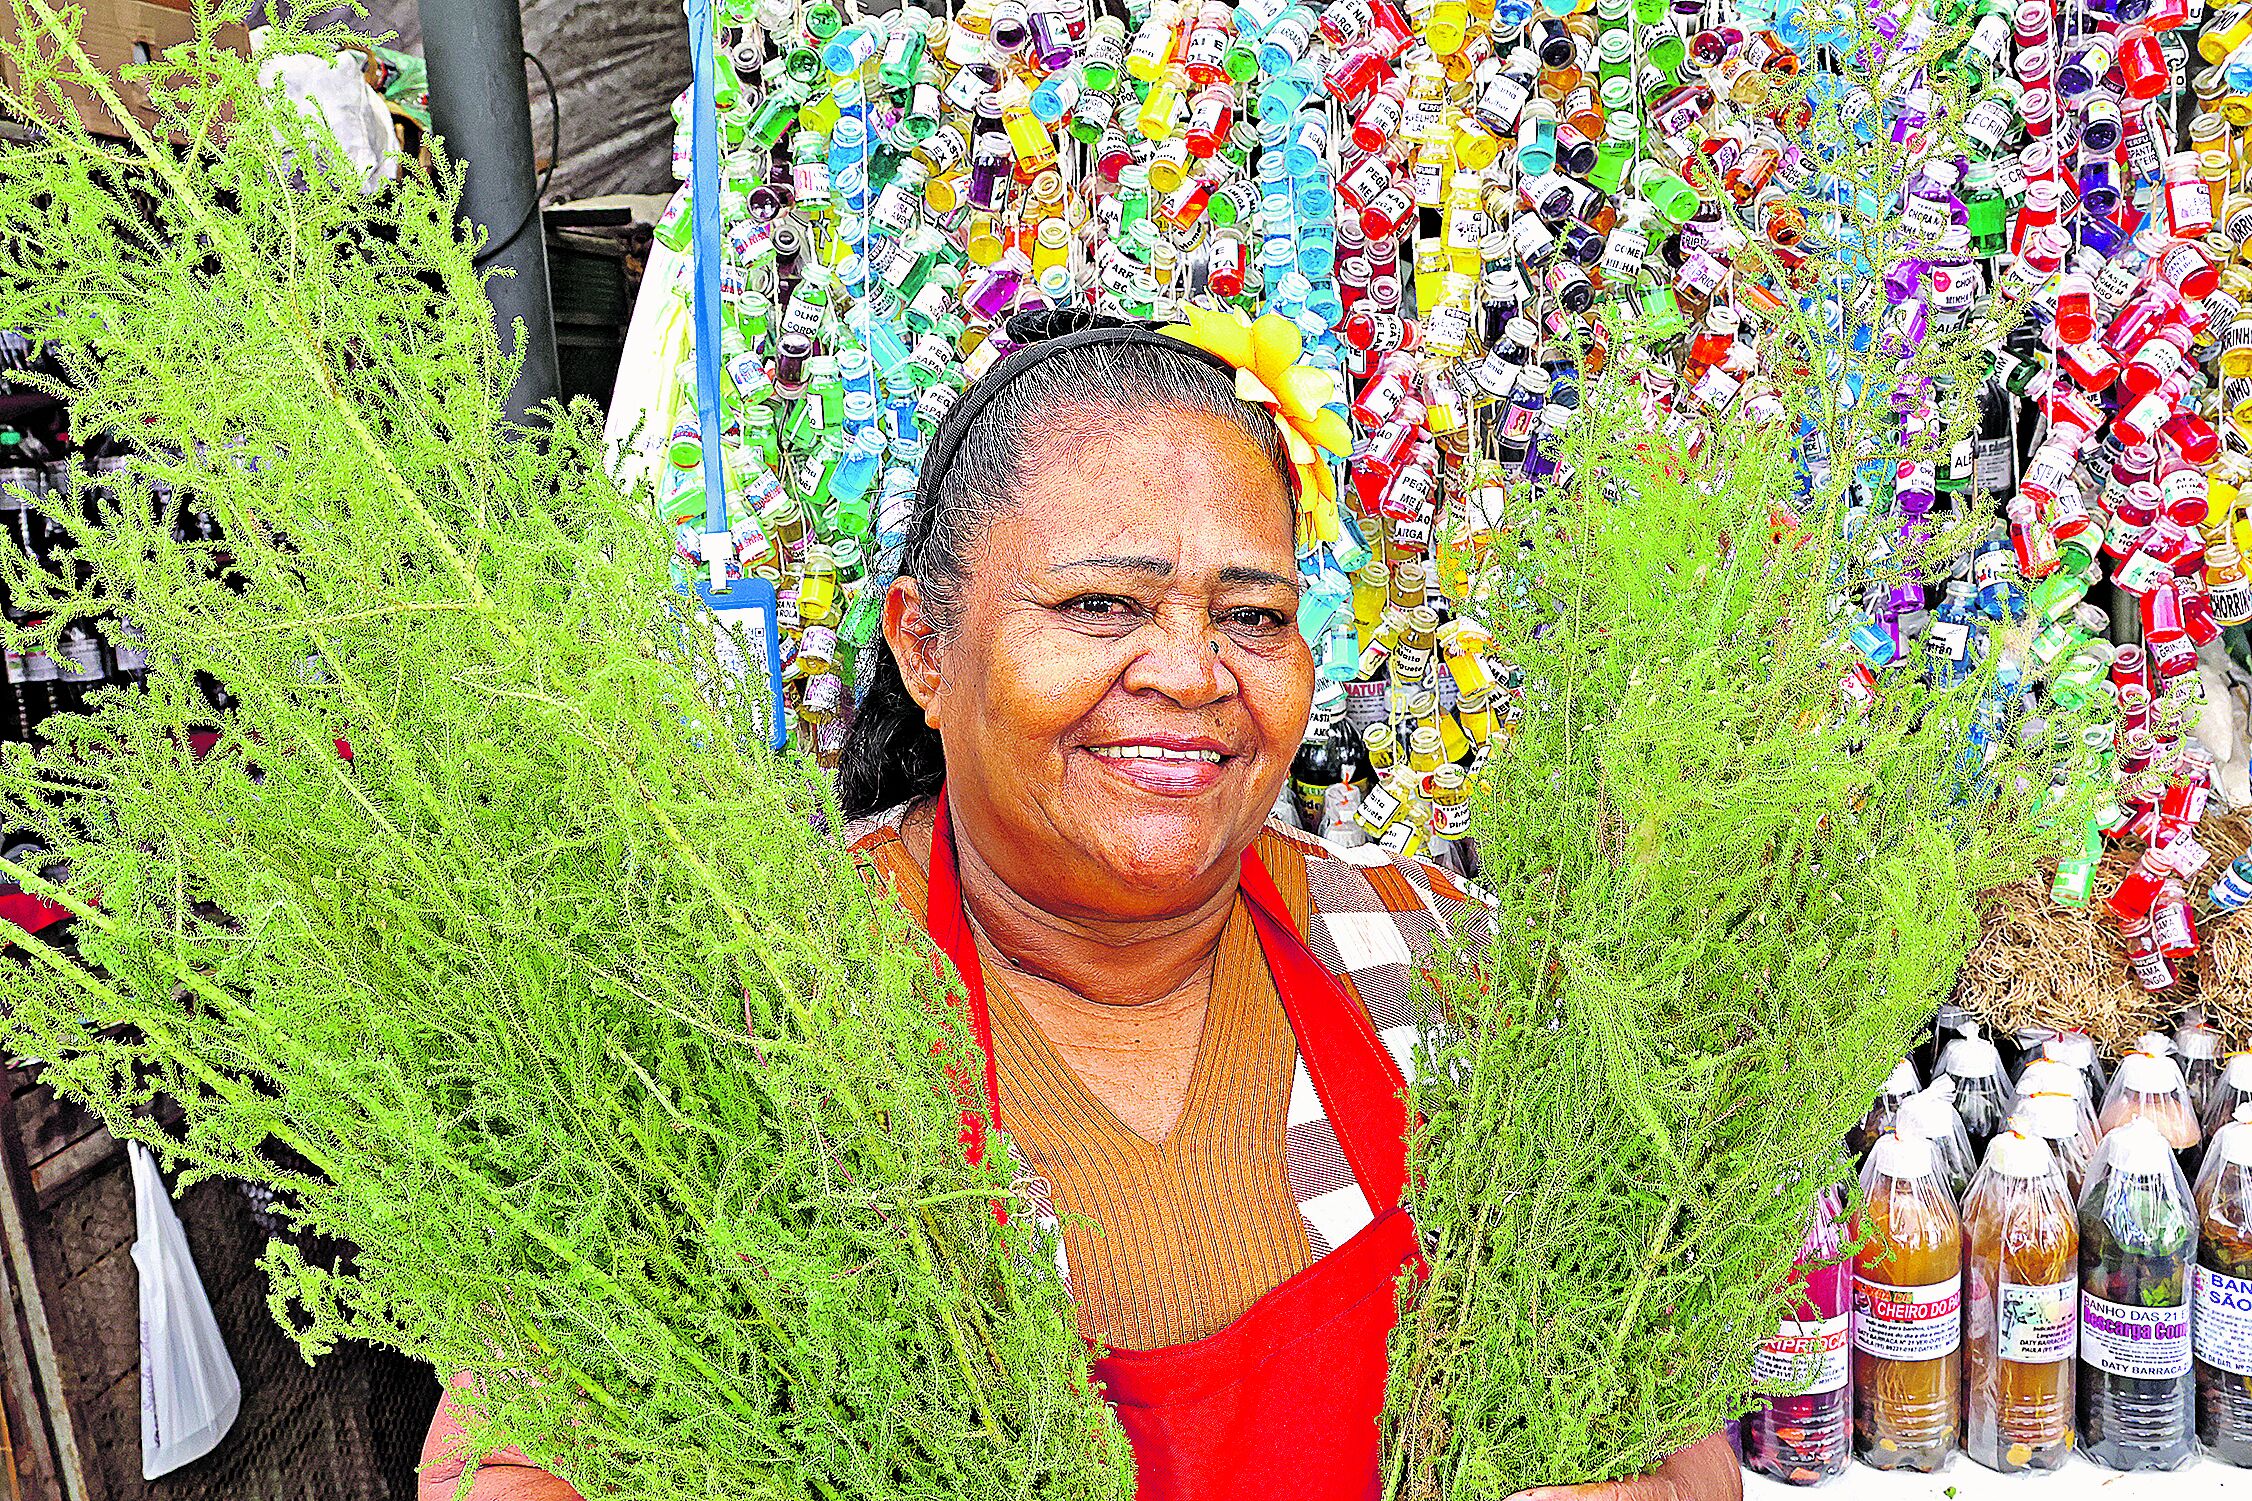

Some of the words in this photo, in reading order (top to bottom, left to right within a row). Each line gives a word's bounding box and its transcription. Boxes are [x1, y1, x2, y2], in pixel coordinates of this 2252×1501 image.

[794, 309, 820, 323] OLHO
[1402, 476, 1427, 496] PEGA
[1395, 527, 1423, 541] ARGA
[1877, 1301, 1928, 1319] CHEIRO
[1930, 1301, 1948, 1318] DO
[2083, 1295, 2126, 1319] BANHO
[2131, 1310, 2160, 1322] DAS
[2163, 1312, 2177, 1322] 21
[2209, 1290, 2252, 1312] SÃO
[2101, 1358, 2130, 1374] DATY
[2131, 1364, 2183, 1376] BARRACA
